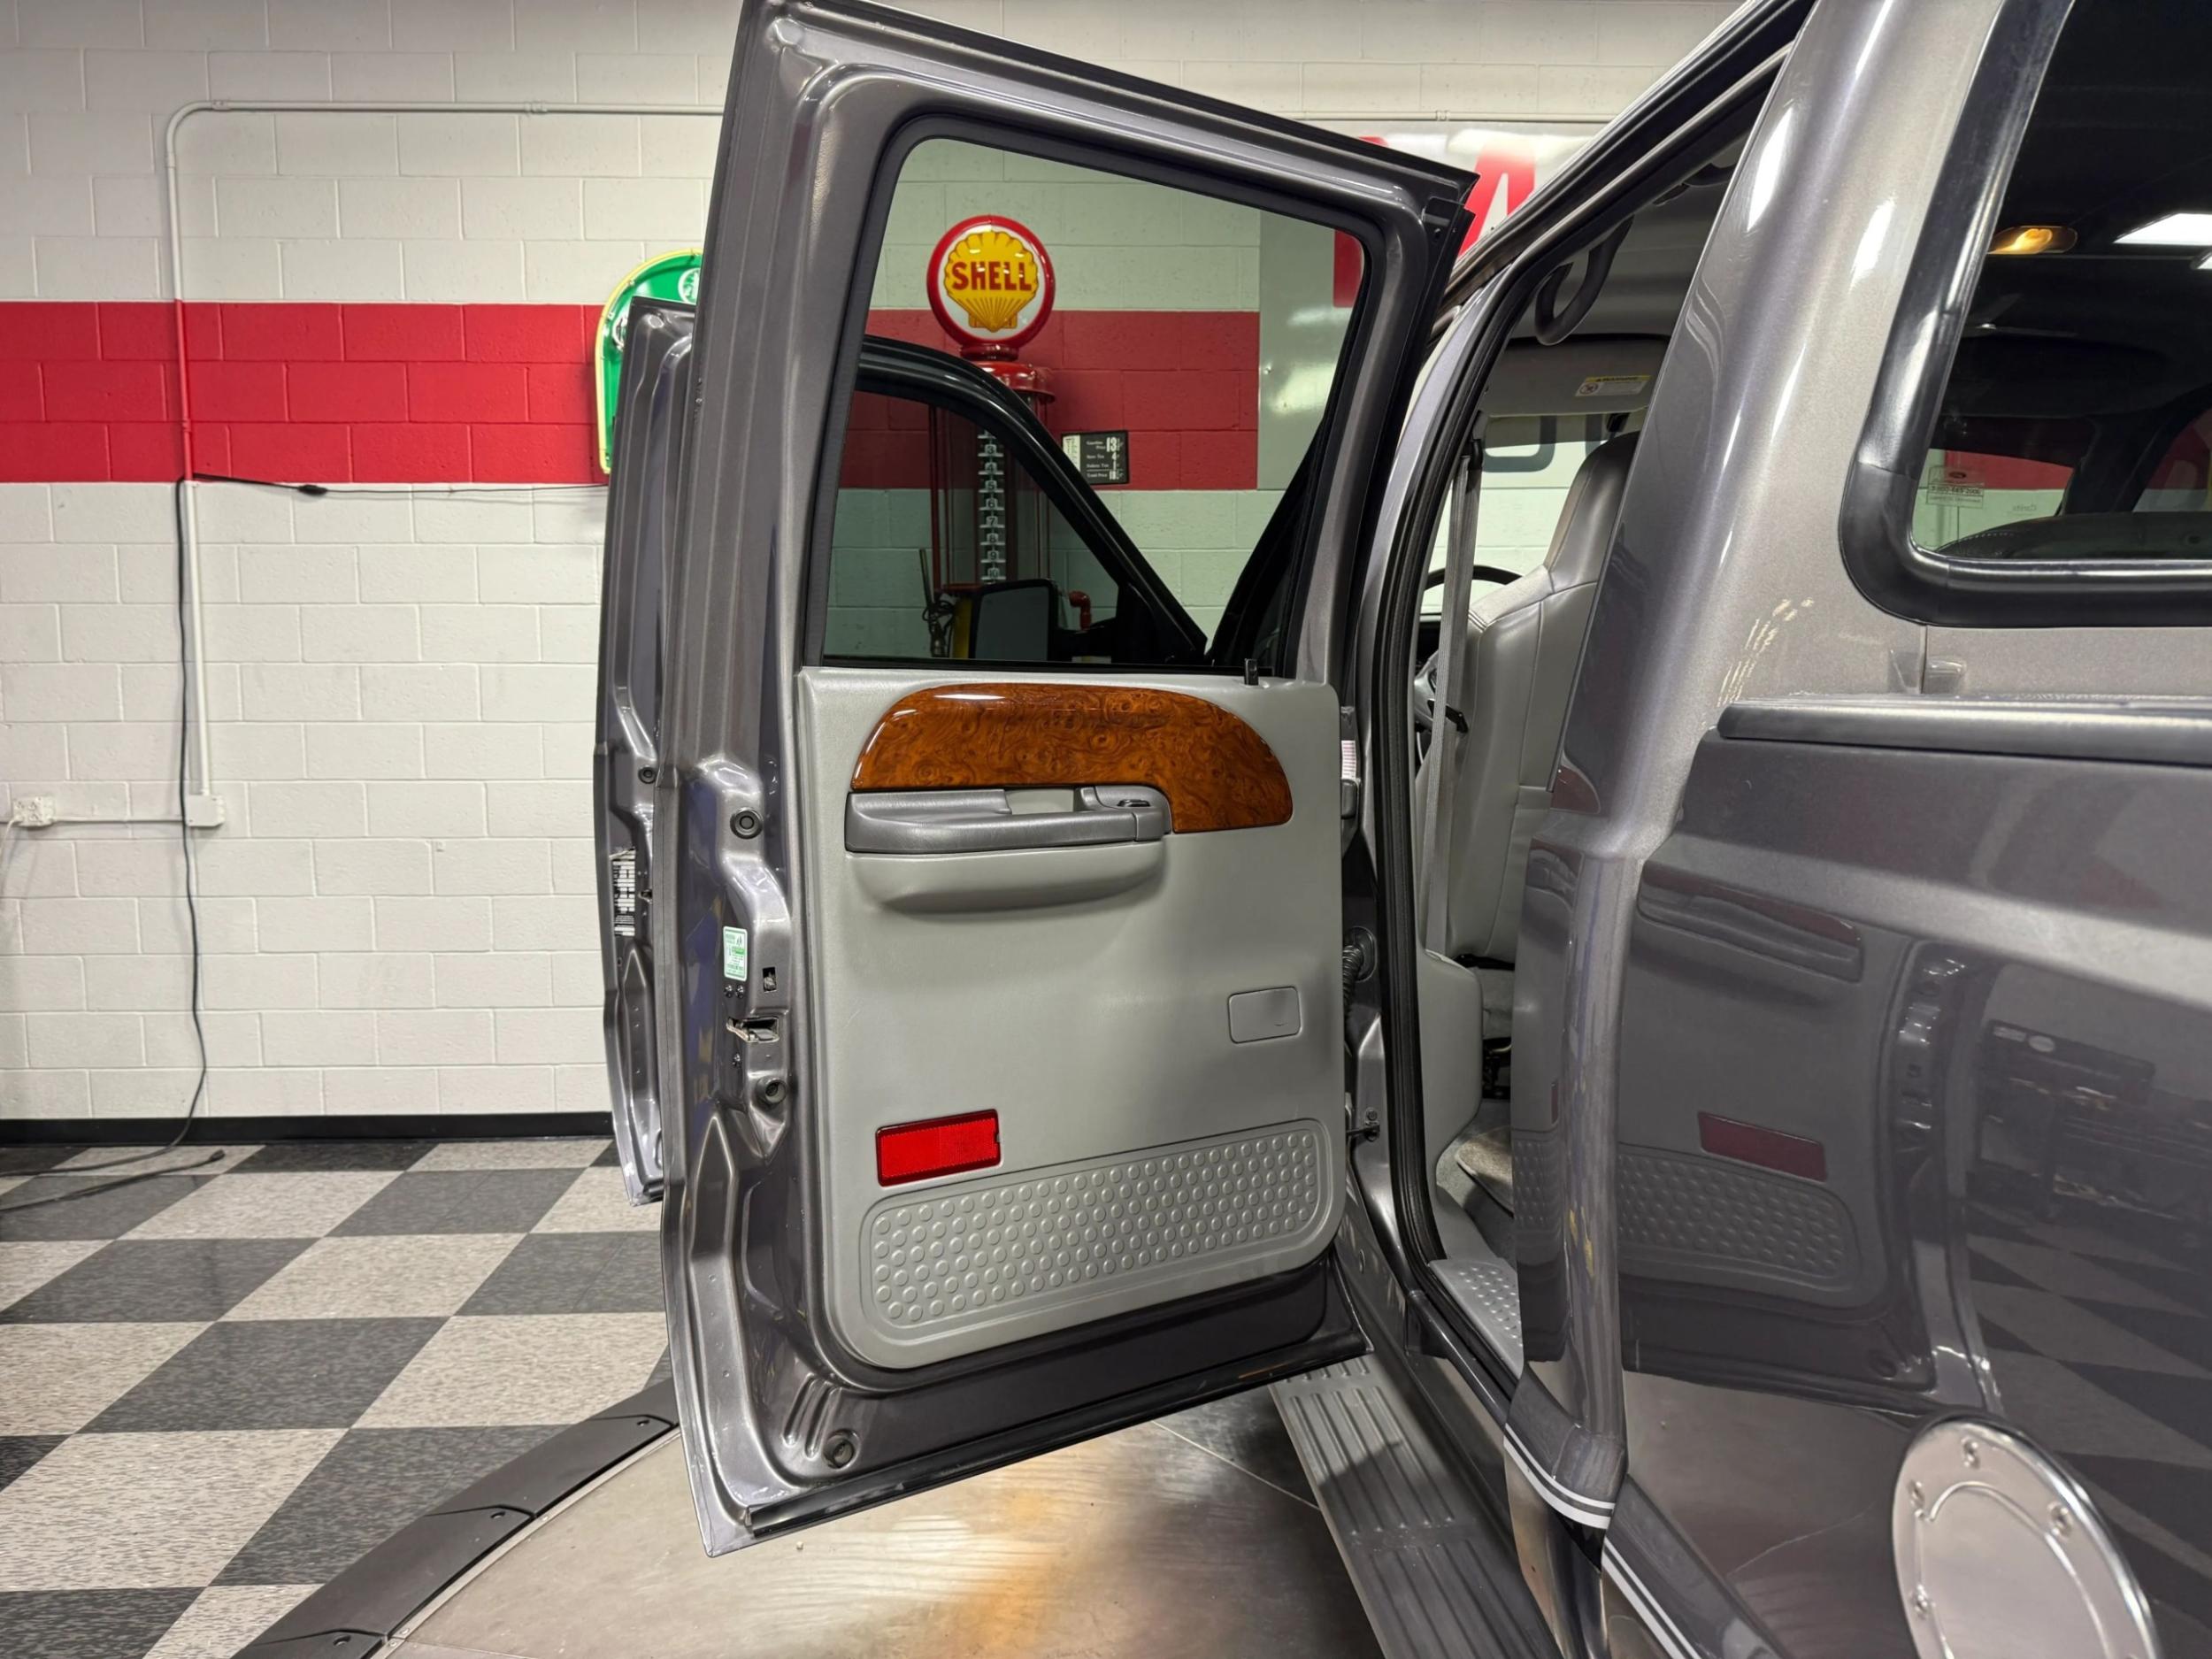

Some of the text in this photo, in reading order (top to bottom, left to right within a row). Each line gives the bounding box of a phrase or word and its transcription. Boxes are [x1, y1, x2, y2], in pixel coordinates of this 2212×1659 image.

[952, 261, 1033, 291] SHELL
[987, 445, 995, 454] 3
[987, 464, 995, 472] 4
[987, 480, 995, 489] 5
[987, 499, 995, 508] 6
[990, 551, 997, 560] 9
[989, 569, 998, 578] 10
